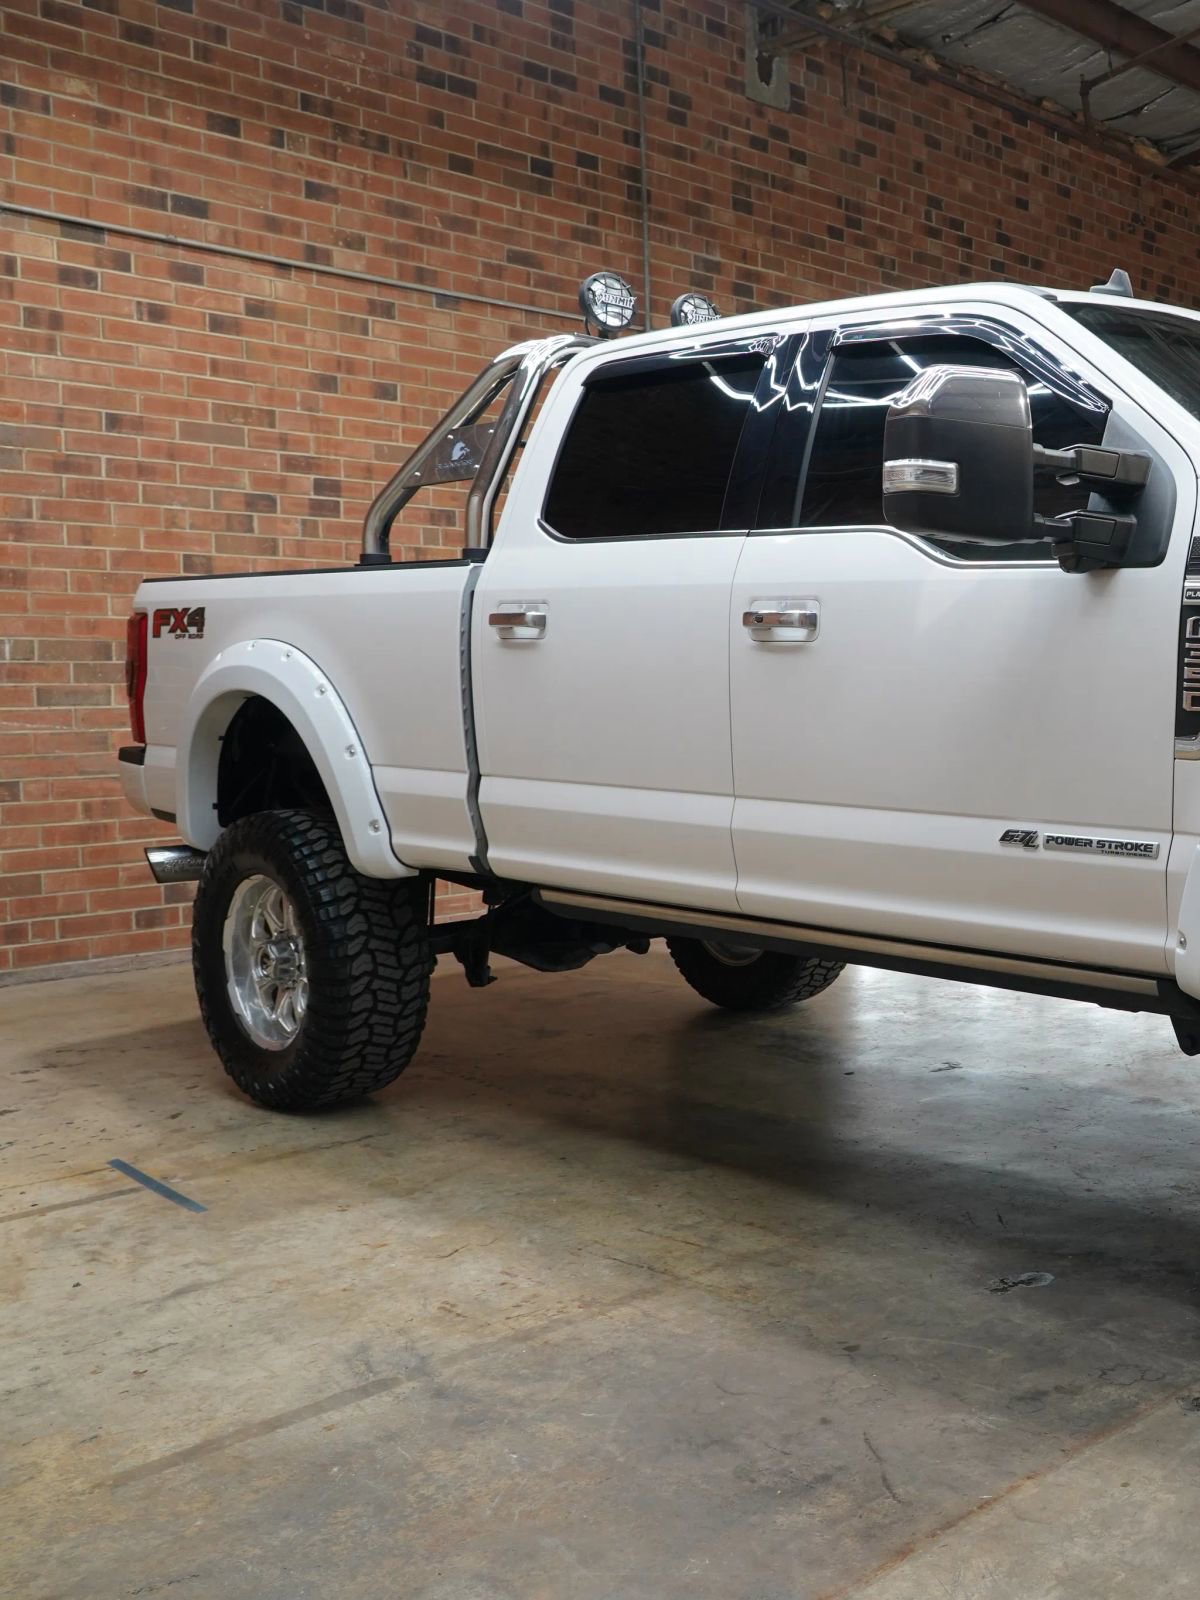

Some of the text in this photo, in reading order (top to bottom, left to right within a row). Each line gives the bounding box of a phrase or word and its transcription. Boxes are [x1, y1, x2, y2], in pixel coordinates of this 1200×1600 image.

[595, 289, 637, 308] SUMMIT
[152, 606, 206, 638] FX4
[1045, 835, 1093, 848] POWER
[1096, 839, 1154, 853] STROKE
